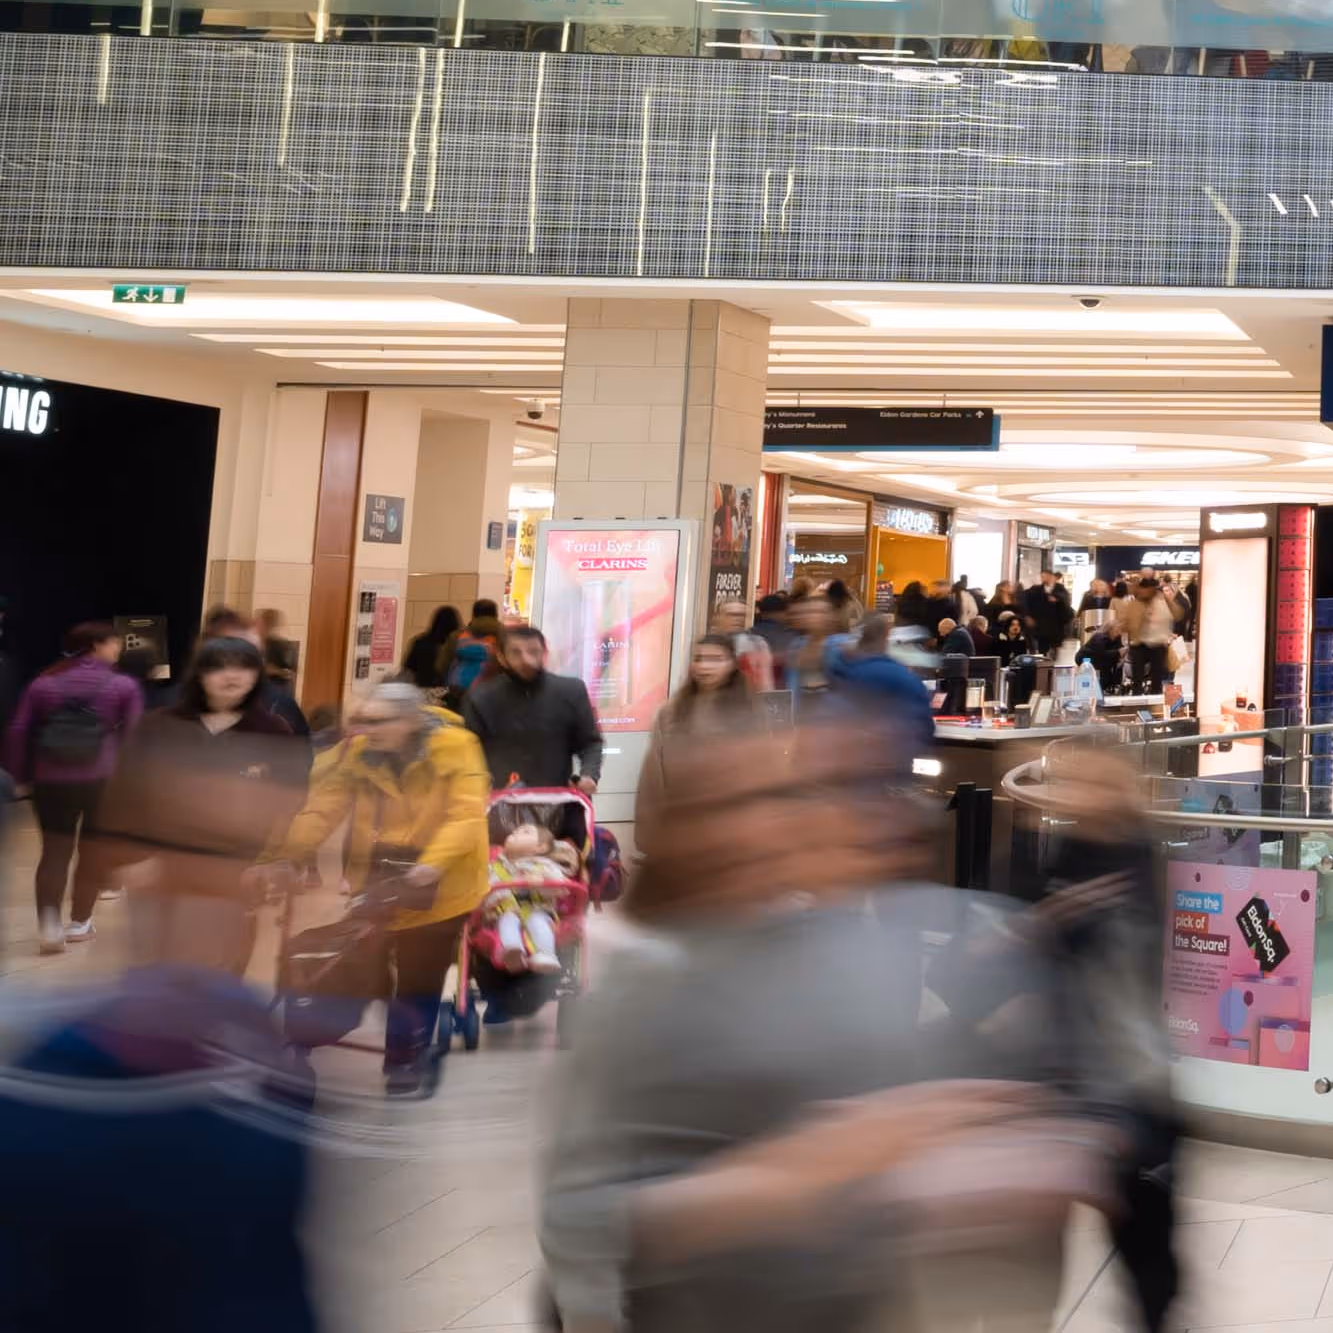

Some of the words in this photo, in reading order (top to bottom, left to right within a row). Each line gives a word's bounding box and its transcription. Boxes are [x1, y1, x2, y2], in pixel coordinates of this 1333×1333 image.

[0, 385, 51, 435] NG
[375, 497, 386, 510] Lift
[372, 511, 385, 524] This
[369, 526, 384, 540] Way
[564, 539, 601, 554] Total
[606, 539, 632, 555] Eye
[578, 558, 649, 570] CLARINS
[1140, 551, 1200, 566] SKE
[1175, 893, 1202, 909] Share
[1203, 896, 1220, 911] the
[1174, 916, 1194, 931] pick
[1195, 915, 1206, 929] of
[1246, 905, 1276, 964] EldonSq.
[1174, 935, 1190, 950] the
[1191, 936, 1228, 954] Square!
